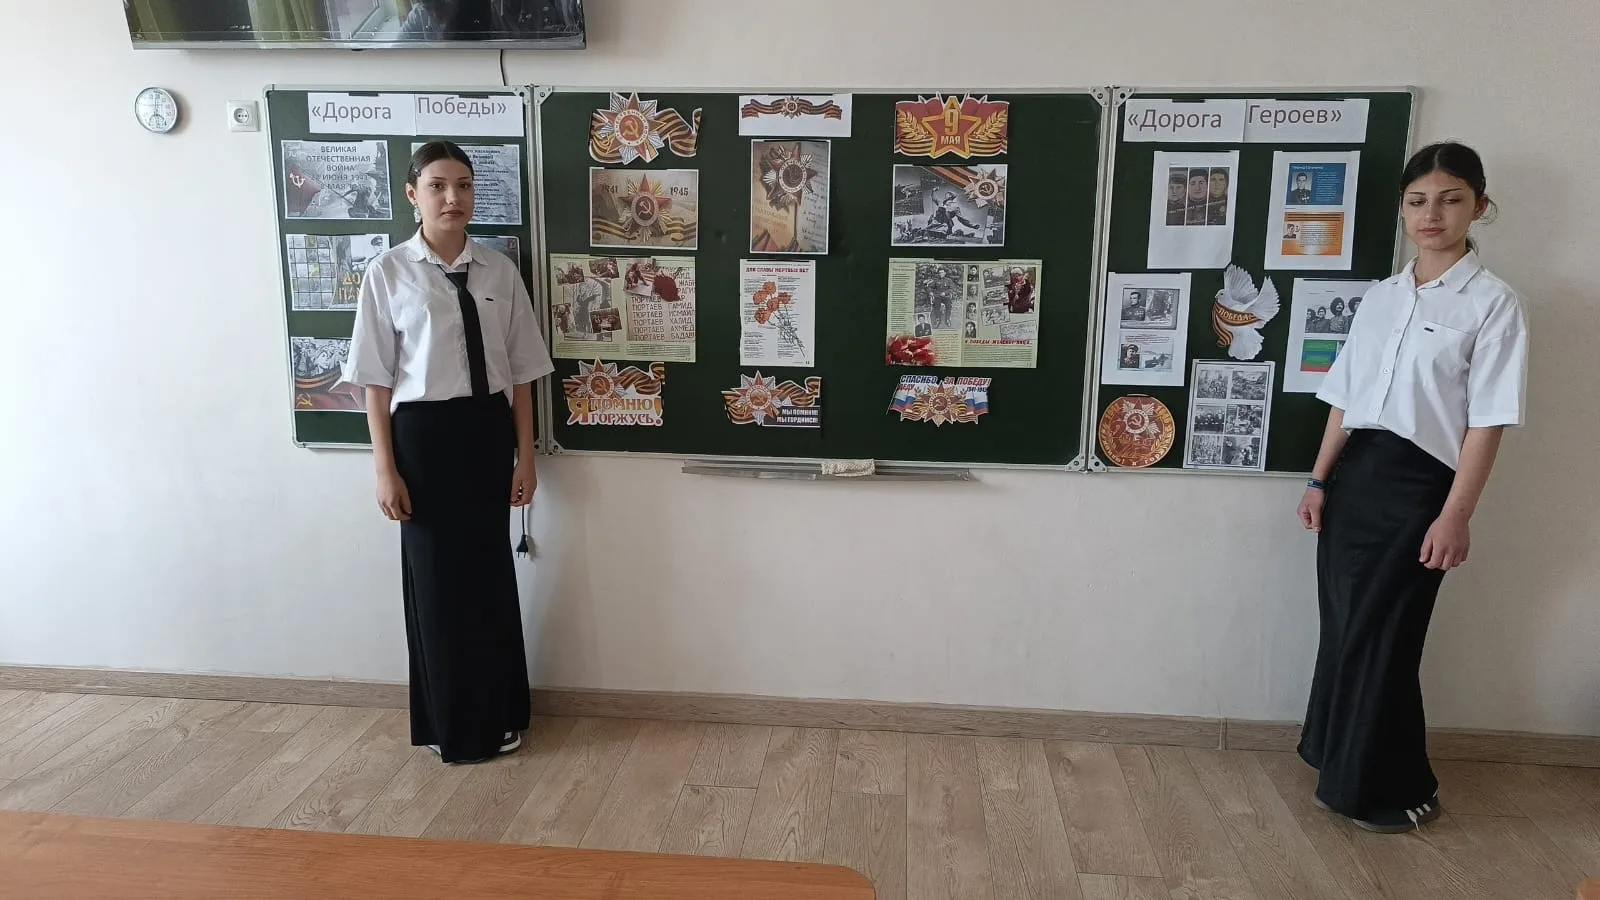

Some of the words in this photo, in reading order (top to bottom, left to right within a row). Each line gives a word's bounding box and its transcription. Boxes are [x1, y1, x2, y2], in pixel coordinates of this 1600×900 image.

[312, 102, 392, 123] «Дорога
[418, 97, 507, 118] Победы»
[1127, 109, 1222, 132] «Дорога
[1249, 105, 1342, 128] Героев»
[944, 108, 959, 135] 9
[321, 145, 357, 153] ВЕЛИКАЯ
[940, 135, 961, 145] МАЯ
[670, 186, 689, 196] 1945
[900, 375, 938, 384] СПАСИБО
[944, 377, 956, 385] ЗА
[568, 398, 589, 424] Я
